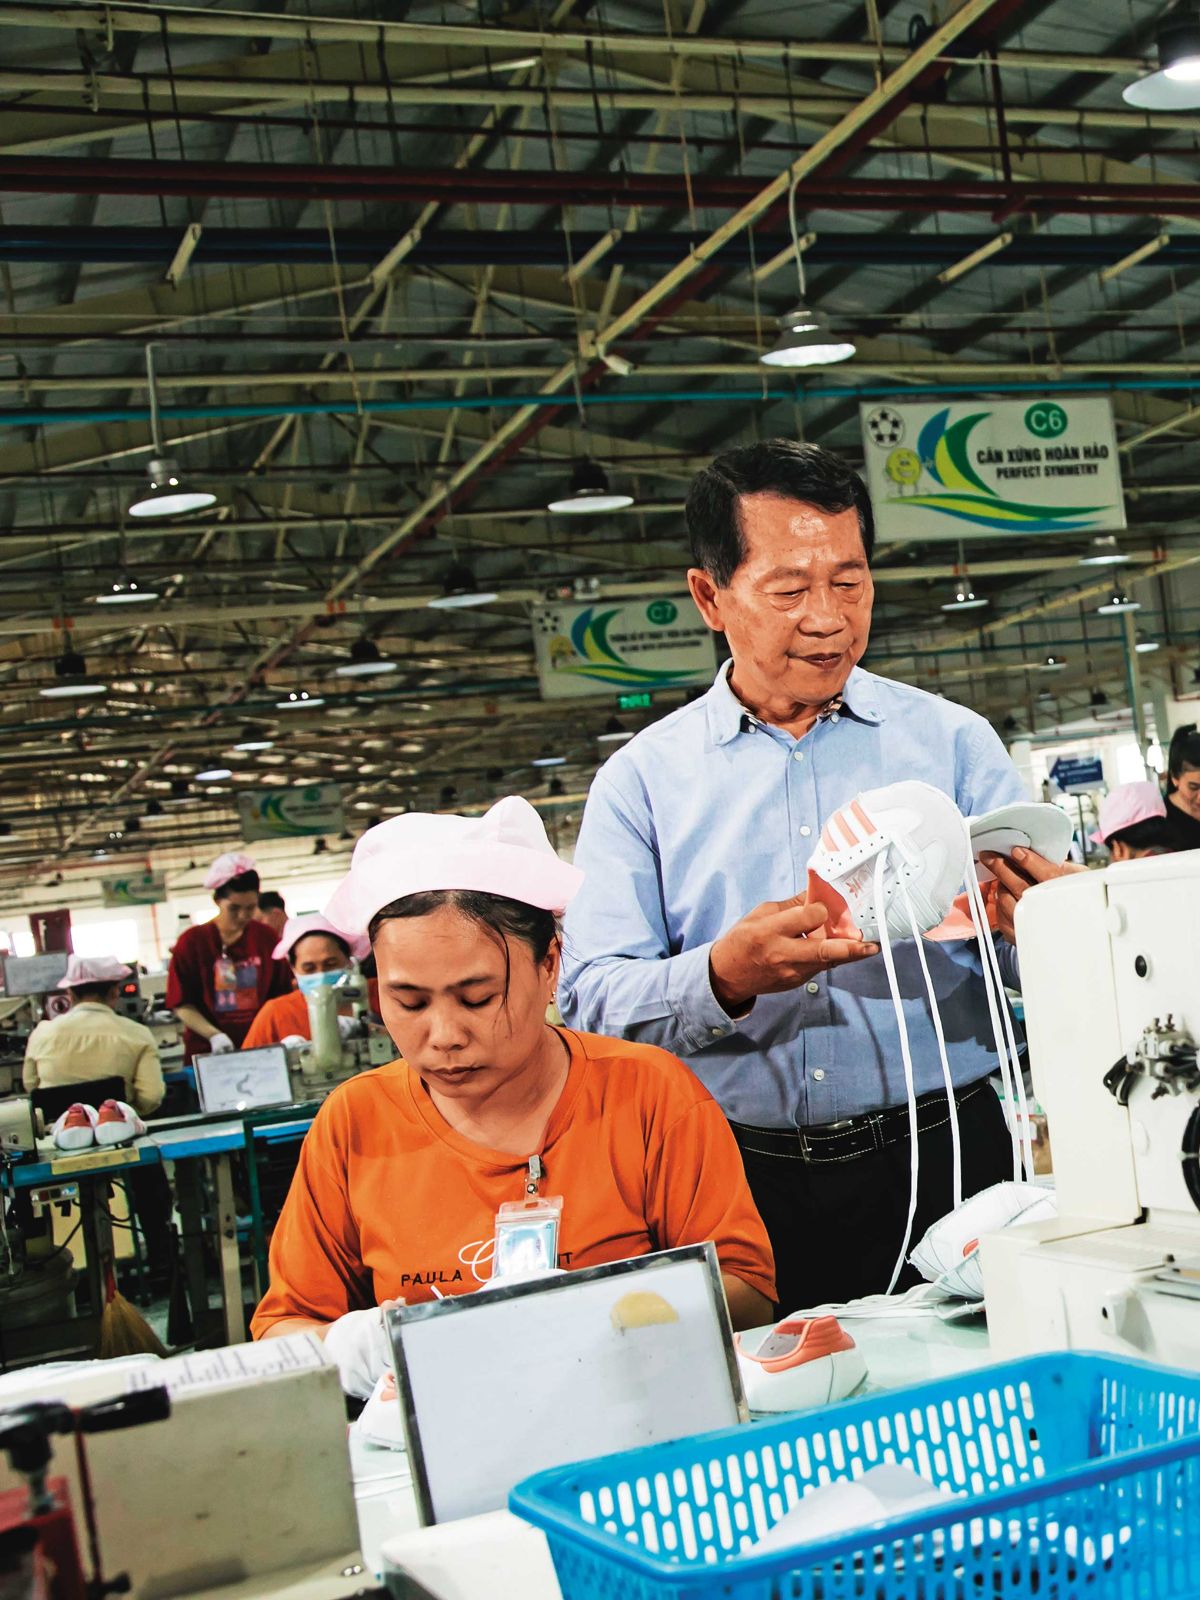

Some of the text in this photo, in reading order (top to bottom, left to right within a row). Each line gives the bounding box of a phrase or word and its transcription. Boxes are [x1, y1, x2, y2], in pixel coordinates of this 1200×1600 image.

[1030, 410, 1063, 431] C6
[997, 463, 1098, 479] PERFECT SYMMETRY
[650, 604, 672, 620] C7
[401, 1269, 462, 1287] PAULA
